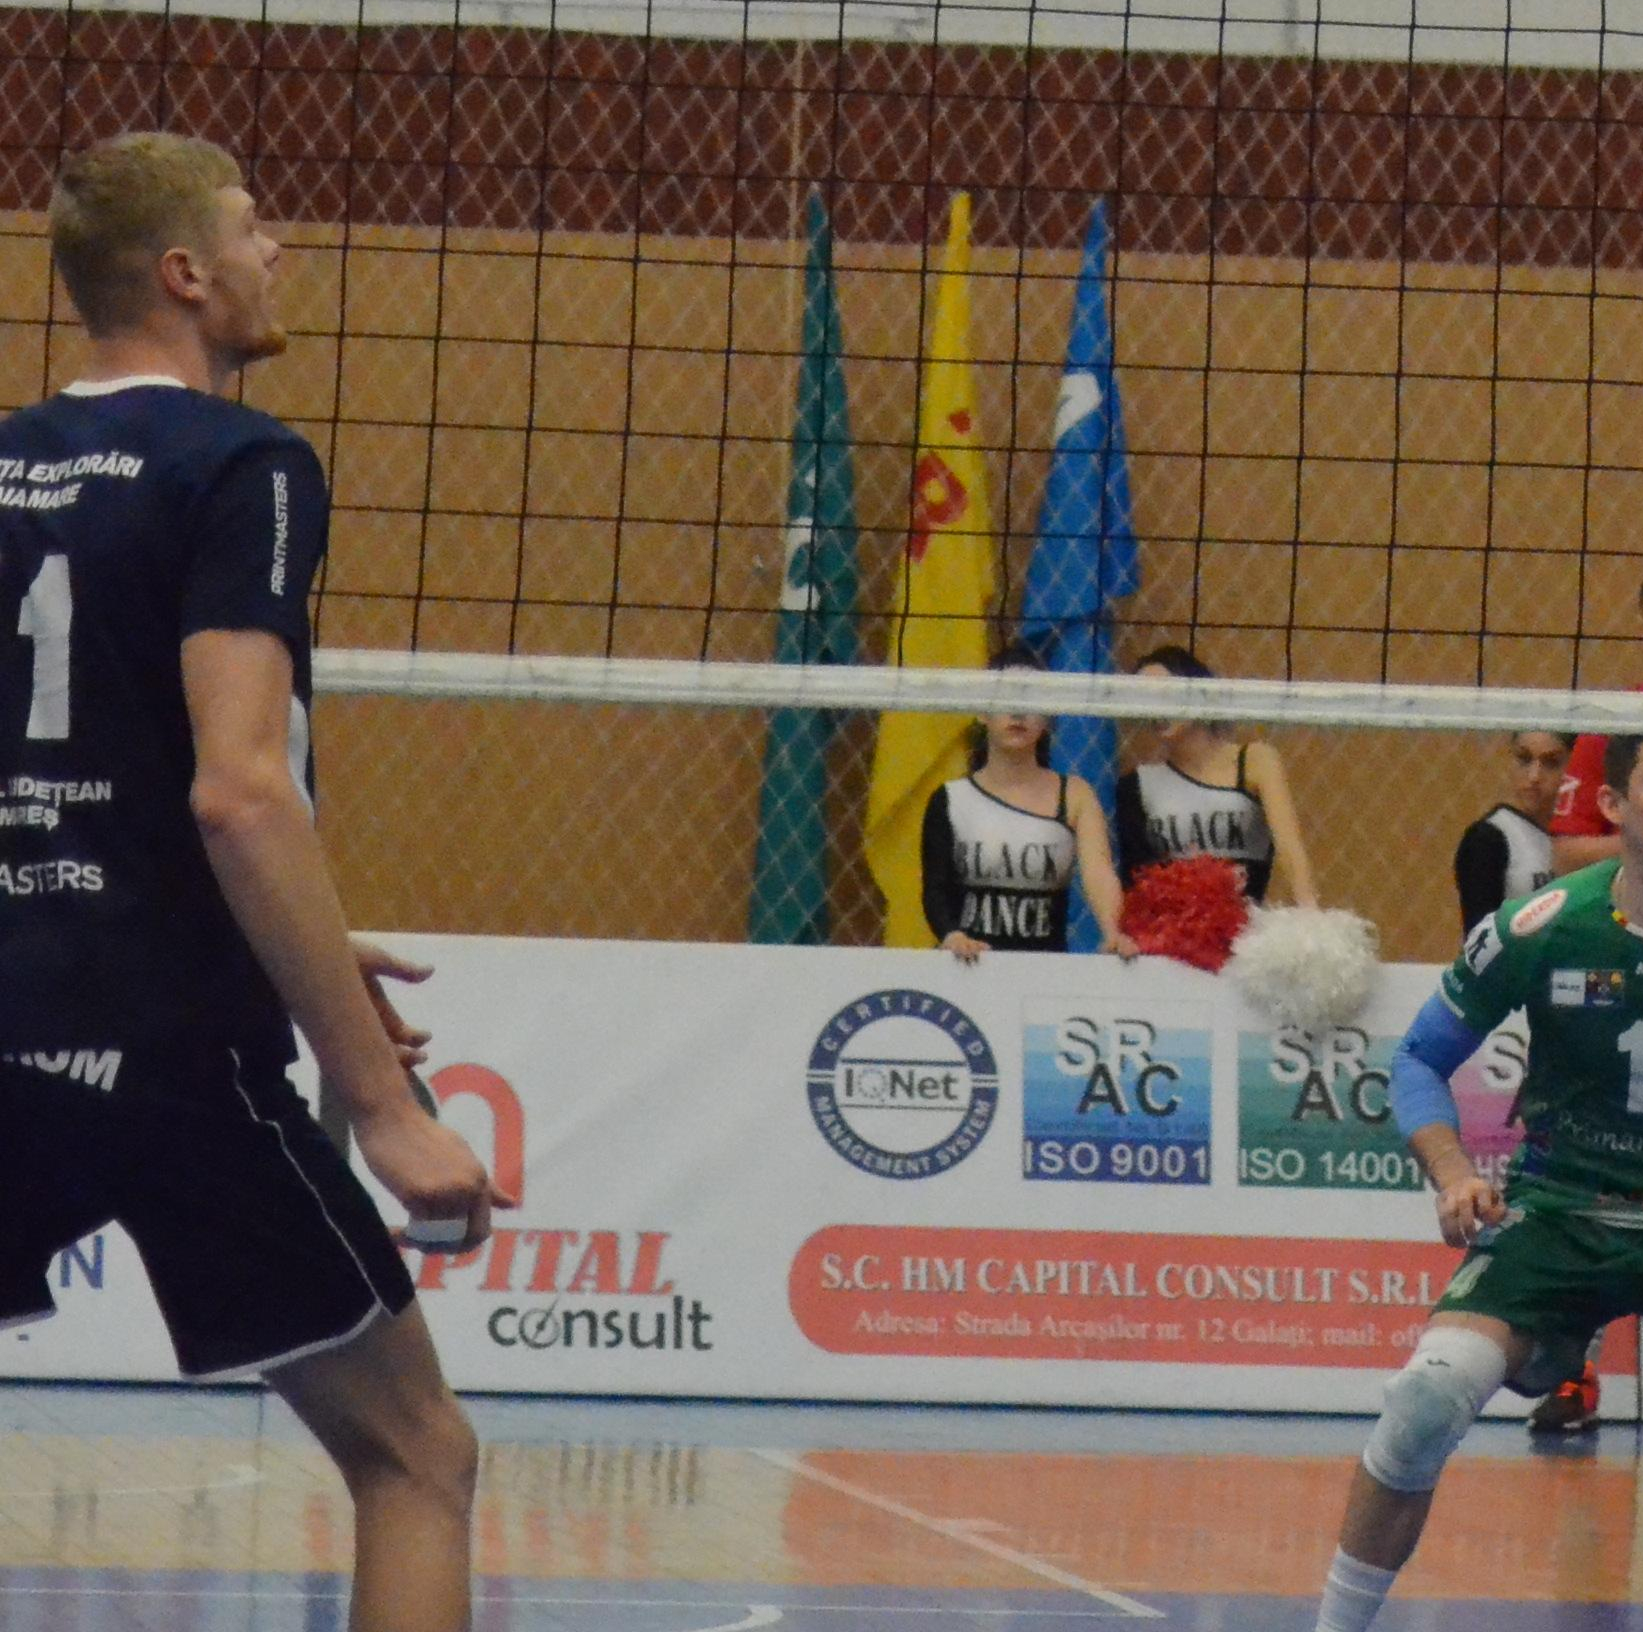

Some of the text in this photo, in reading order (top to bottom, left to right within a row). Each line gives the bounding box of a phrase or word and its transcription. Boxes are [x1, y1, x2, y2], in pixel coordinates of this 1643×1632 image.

[27, 482, 83, 510] MARE
[271, 471, 288, 597] PRINTMASTERS
[17, 553, 73, 740] 1
[1146, 808, 1247, 855] BLACK
[956, 840, 1061, 884] BLACK
[959, 894, 1053, 940] DANCE
[821, 994, 985, 1057] CERTIFIED
[845, 1068, 959, 1103] IQNet
[1076, 1062, 1183, 1118] AC
[814, 1095, 991, 1176] MANAGEMENT SYSTEM
[1024, 1141, 1209, 1179] ISO 9001
[1239, 1148, 1421, 1185] ISO 14001
[820, 1251, 892, 1291] S.C.
[900, 1255, 968, 1293] HM
[975, 1257, 1148, 1298] CAPITAL
[1155, 1263, 1340, 1304] CONSULT
[487, 1295, 714, 1351] consult
[954, 1310, 1032, 1338] Strada
